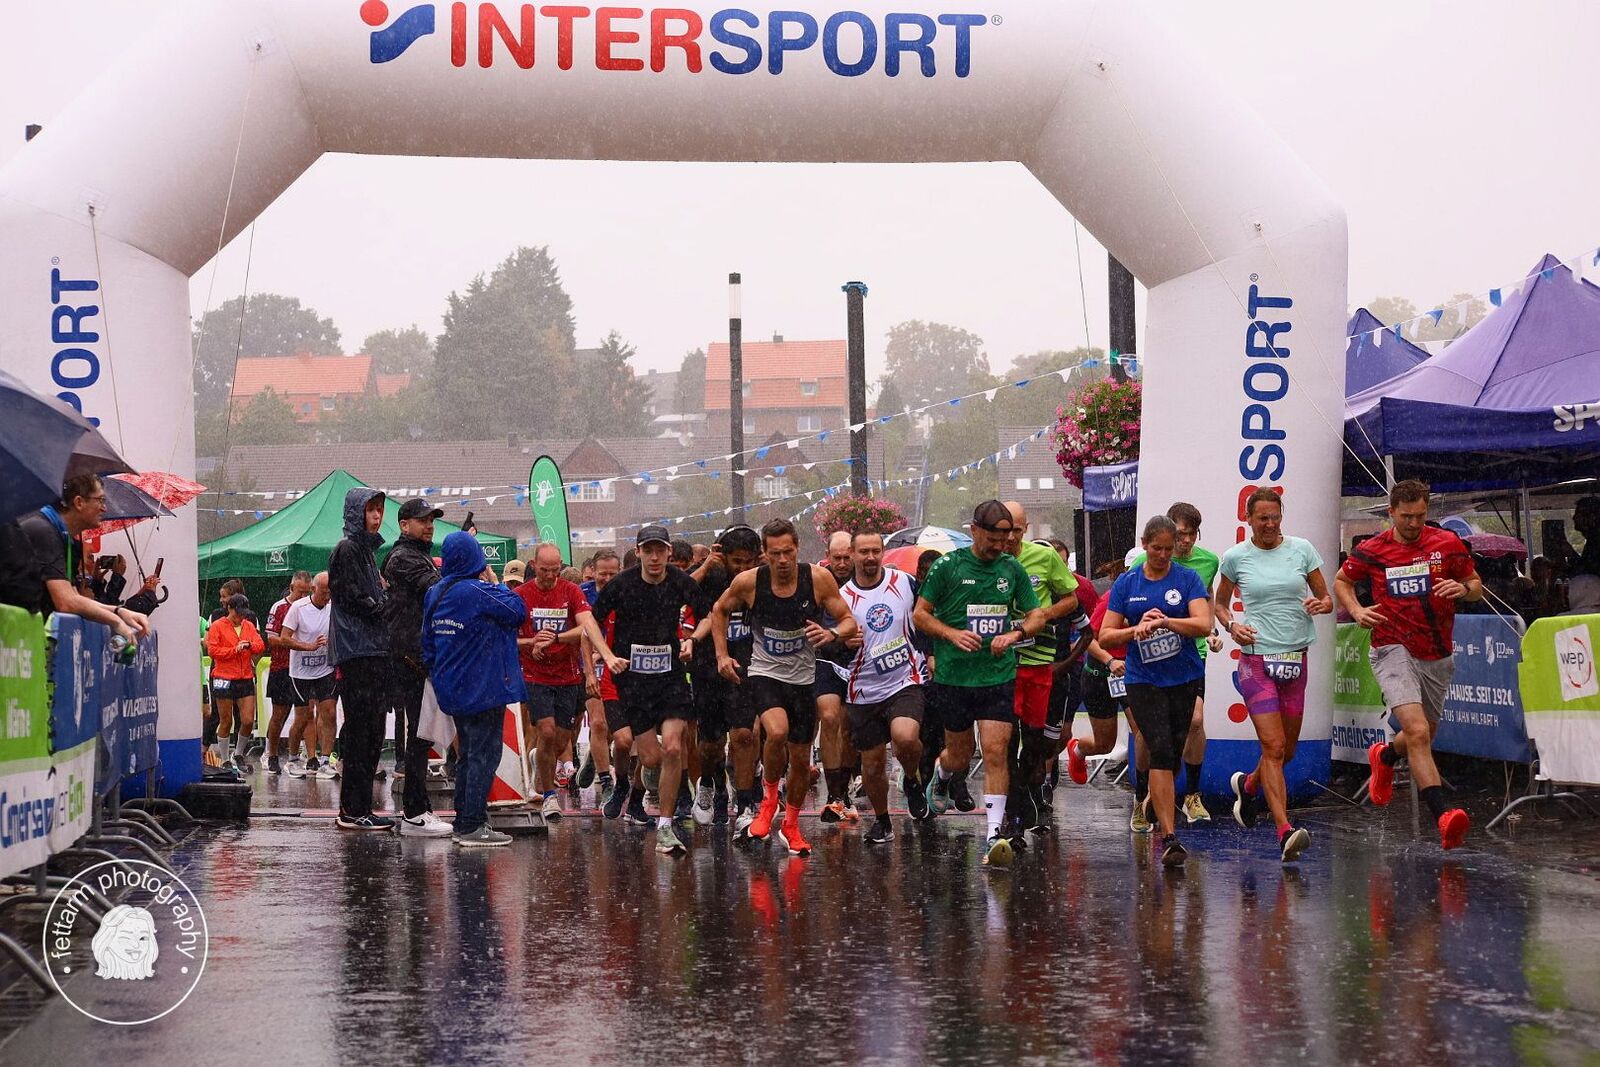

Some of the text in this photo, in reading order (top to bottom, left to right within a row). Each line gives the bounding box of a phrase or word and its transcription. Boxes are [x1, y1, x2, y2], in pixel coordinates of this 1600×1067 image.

[1390, 578, 1427, 595] 1651
[969, 605, 1007, 615] wepLAUF
[535, 619, 566, 631] 1657
[970, 619, 1004, 634] 1691
[1142, 636, 1180, 658] 1682
[633, 656, 669, 669] 1684
[877, 648, 909, 671] 1693
[1560, 652, 1584, 670] wep
[1267, 664, 1301, 680] 1459
[1335, 672, 1360, 694] ärme
